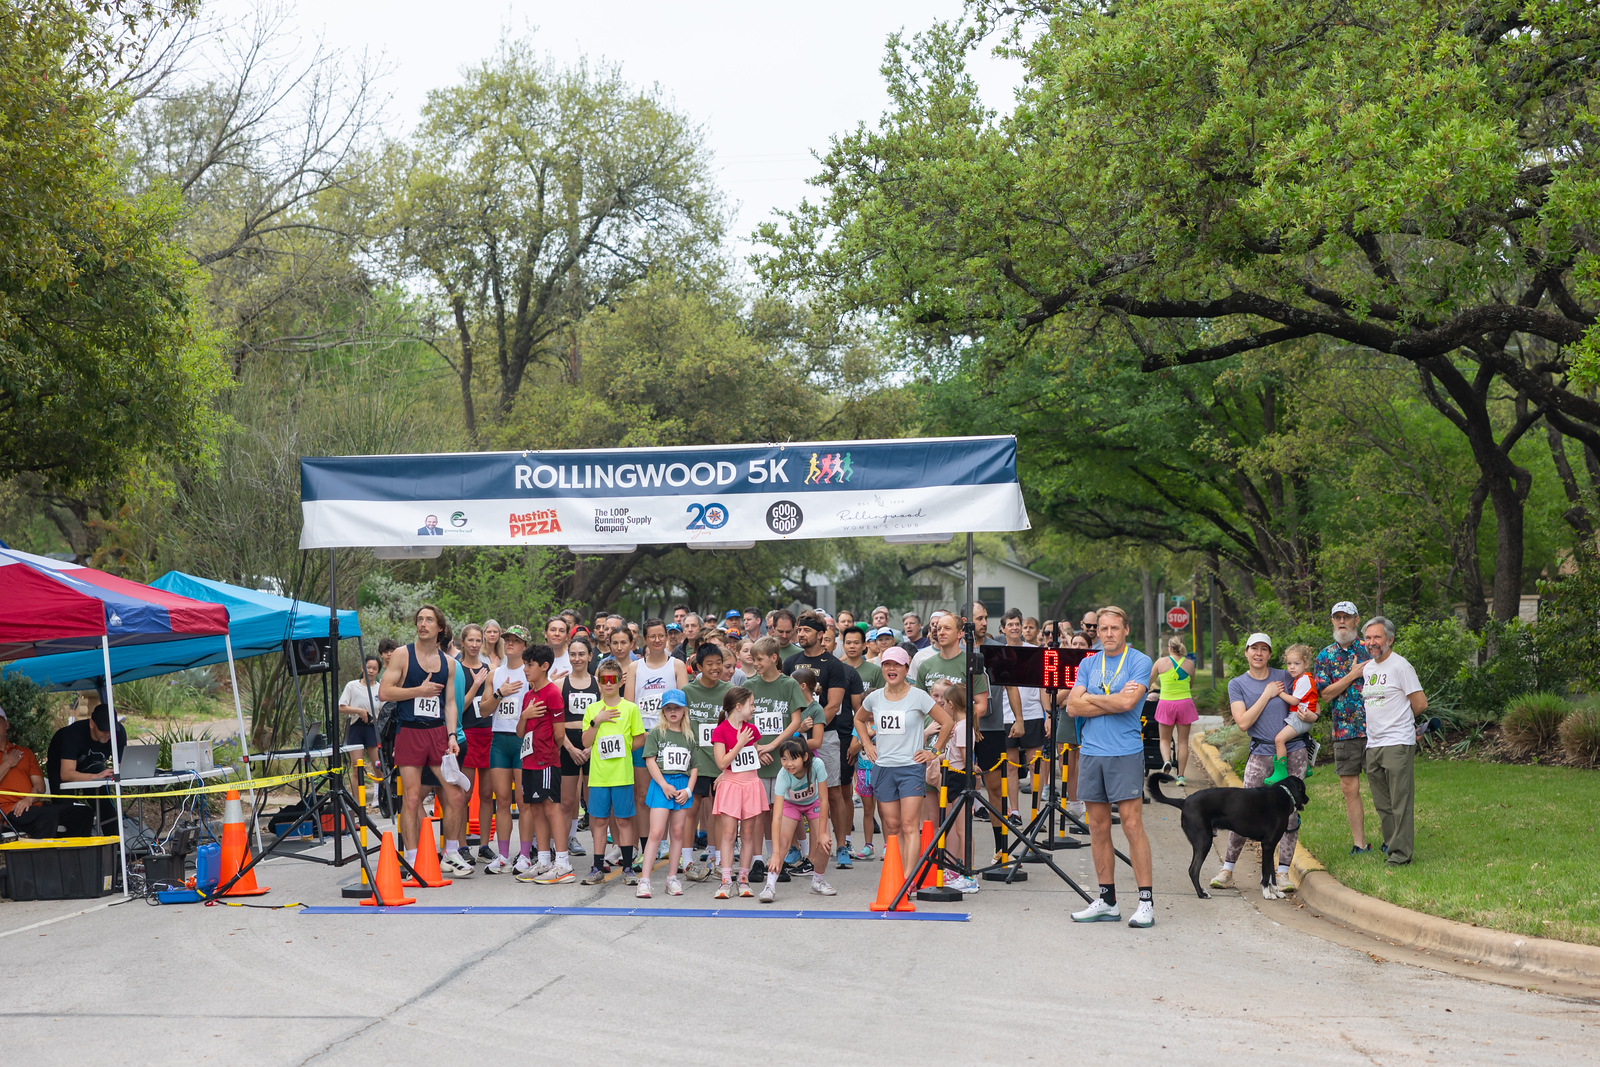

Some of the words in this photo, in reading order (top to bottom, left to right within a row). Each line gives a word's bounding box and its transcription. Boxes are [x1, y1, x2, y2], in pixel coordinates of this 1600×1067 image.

[515, 462, 737, 489] ROLLINGWOOD
[748, 458, 790, 484] 5K
[509, 508, 557, 523] Austin's
[610, 508, 629, 516] LOOP
[686, 502, 729, 529] 20
[772, 504, 797, 518] GOOD
[836, 508, 926, 523] Rollingwood
[595, 516, 625, 525] Running
[626, 516, 652, 525] Supply
[772, 518, 797, 531] GOOD
[509, 518, 562, 538] PIZZA
[595, 524, 629, 533] Company
[1168, 613, 1188, 623] STOP
[1365, 674, 1387, 686] 2013
[418, 698, 437, 712] 457
[499, 702, 514, 714] 456
[643, 698, 661, 712] 452
[700, 701, 713, 710] Keep
[689, 708, 709, 718] Rolling
[759, 716, 779, 730] 540
[880, 715, 900, 729] 621
[601, 740, 621, 754] 904
[668, 752, 688, 765] 507
[734, 751, 754, 767] 905
[794, 787, 814, 800] 609
